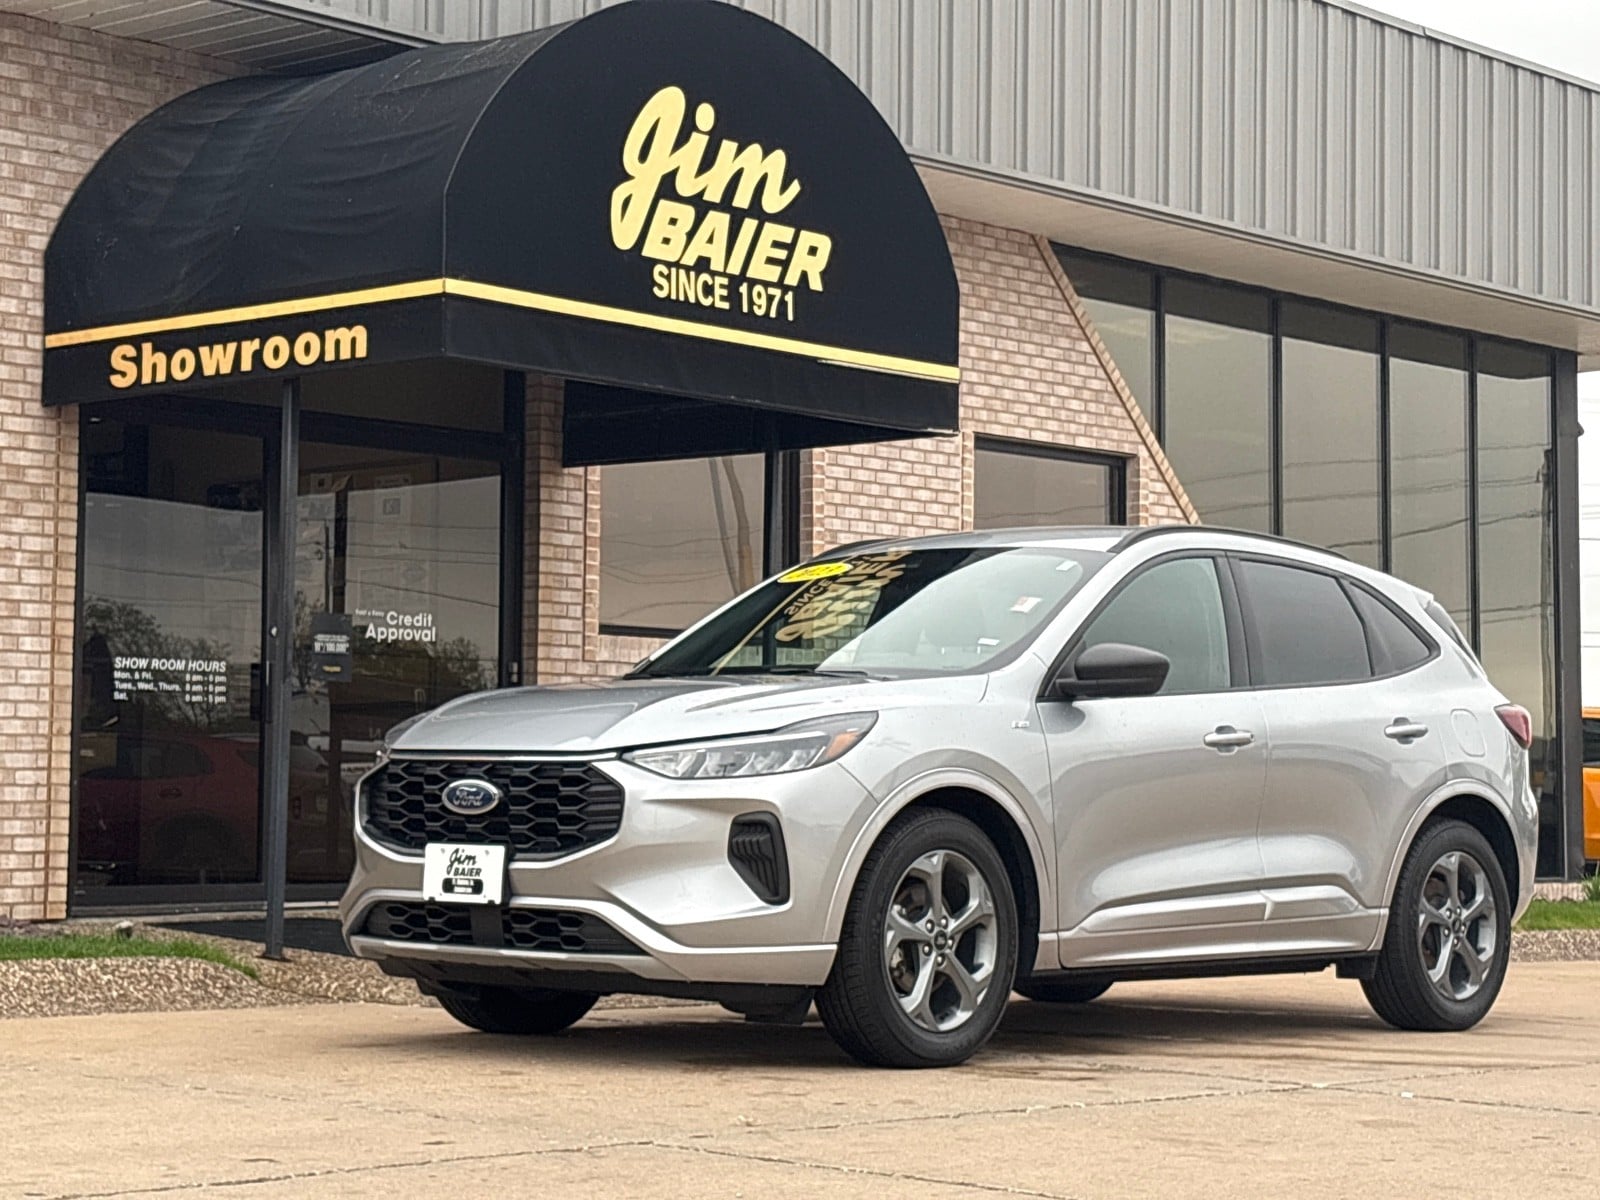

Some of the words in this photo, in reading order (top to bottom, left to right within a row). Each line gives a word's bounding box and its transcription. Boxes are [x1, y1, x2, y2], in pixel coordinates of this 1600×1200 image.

[611, 85, 801, 251] Jim
[641, 199, 832, 292] BAIER
[652, 264, 730, 310] SINCE
[739, 282, 794, 321] 1971
[109, 325, 368, 389] Showroom
[386, 610, 433, 627] Credit
[364, 622, 436, 643] Approval
[114, 656, 149, 670] SHOW
[151, 658, 186, 671] ROOM
[187, 660, 227, 672] HOURS
[452, 786, 484, 807] Ford
[446, 848, 477, 876] Jim
[453, 867, 482, 877] BAIER
